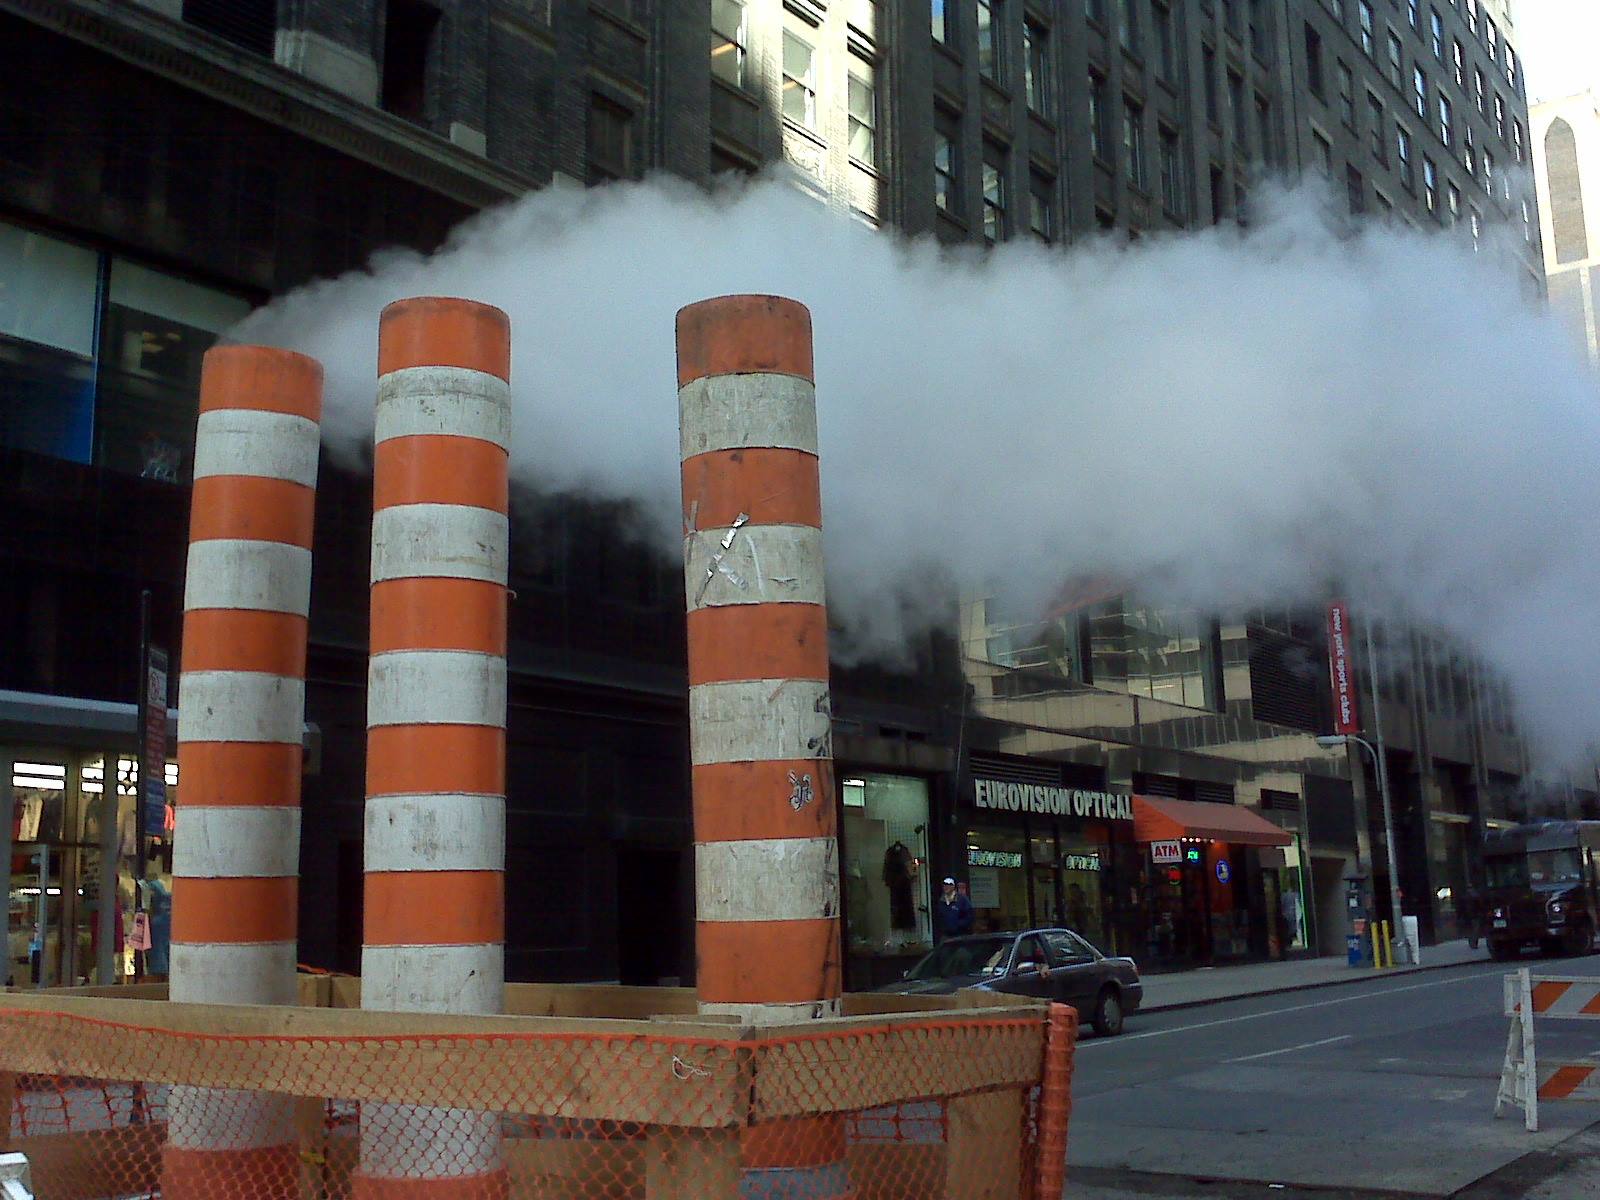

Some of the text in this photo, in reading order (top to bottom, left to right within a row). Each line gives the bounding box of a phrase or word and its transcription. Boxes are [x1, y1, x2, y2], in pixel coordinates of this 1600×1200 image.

[1334, 633, 1345, 657] york
[1336, 659, 1348, 693] sports
[1340, 695, 1350, 725] clubs
[975, 778, 1134, 820] EUROVISION OPTICAL
[1154, 845, 1179, 857] ATM
